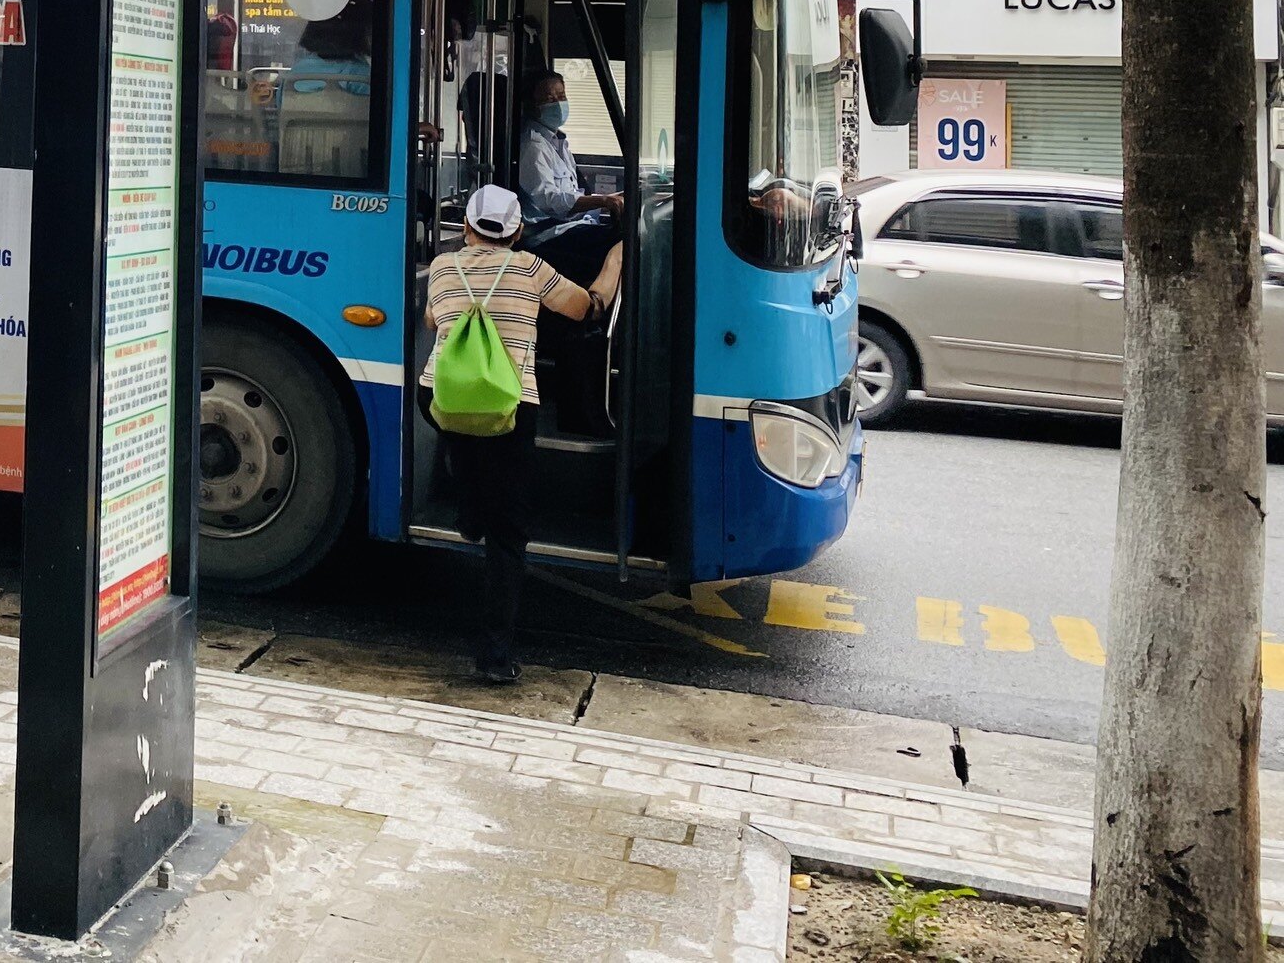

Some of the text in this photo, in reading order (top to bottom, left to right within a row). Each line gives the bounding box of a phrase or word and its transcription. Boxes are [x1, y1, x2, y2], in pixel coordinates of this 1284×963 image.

[245, 8, 261, 19] spa
[266, 24, 281, 36] Học
[938, 89, 985, 104] SALE
[937, 117, 998, 162] 99 K
[330, 193, 390, 214] BC095
[202, 242, 330, 278] NOIBUS
[0, 465, 23, 478] bệnh
